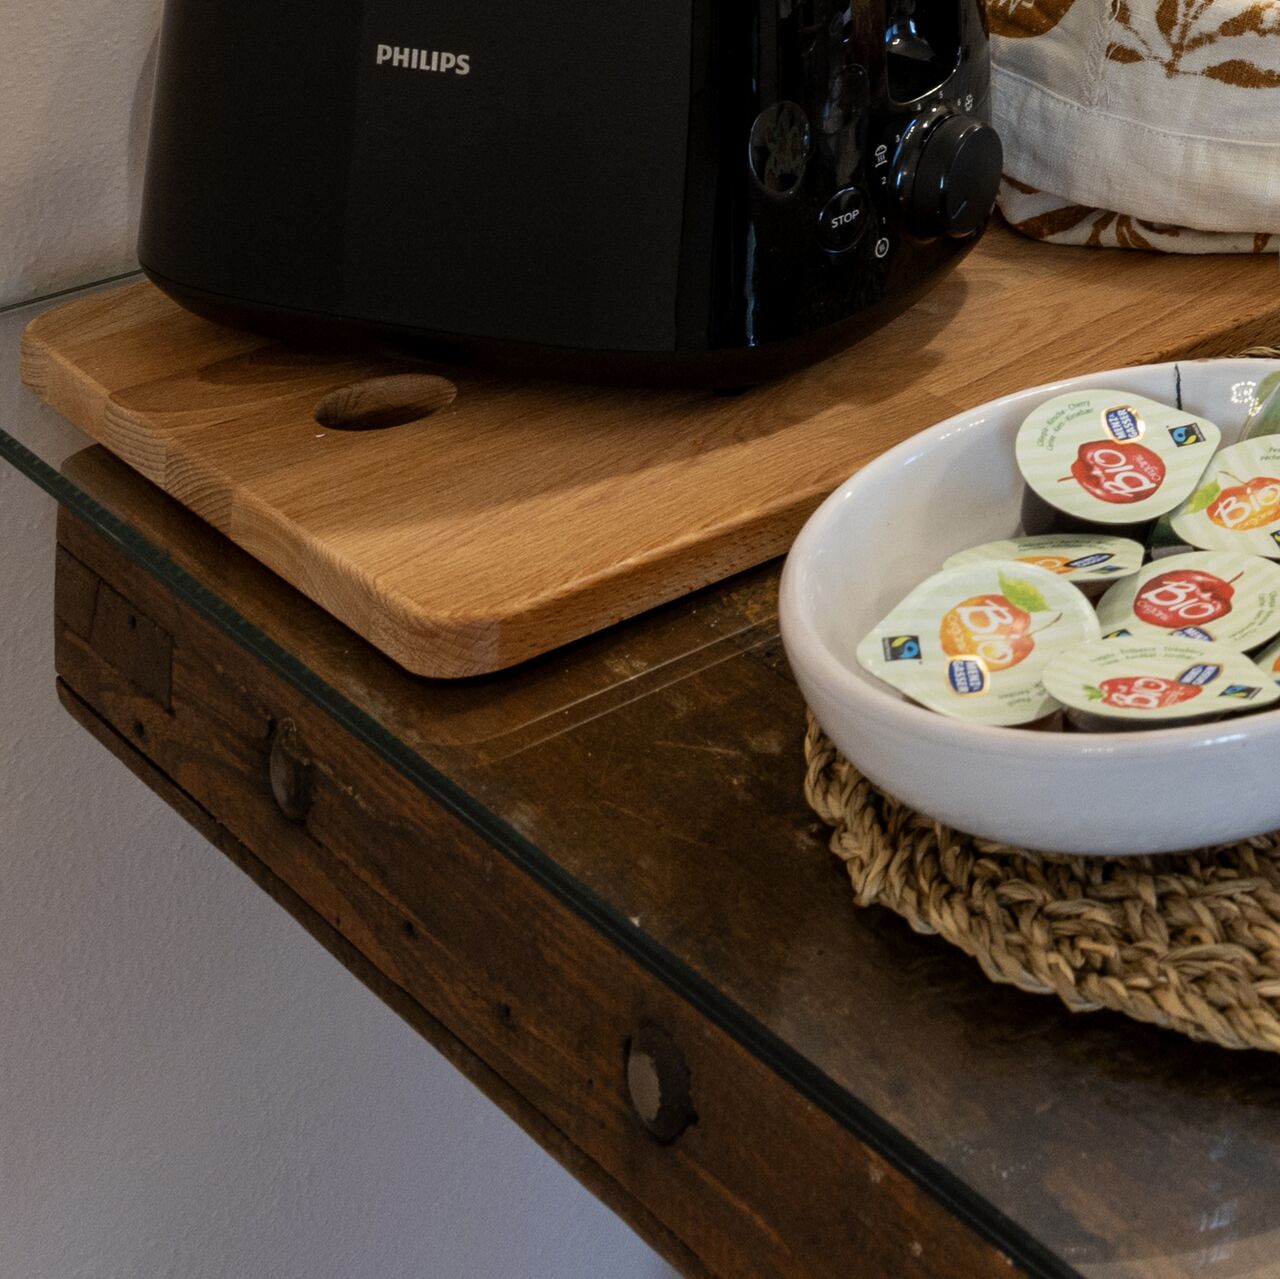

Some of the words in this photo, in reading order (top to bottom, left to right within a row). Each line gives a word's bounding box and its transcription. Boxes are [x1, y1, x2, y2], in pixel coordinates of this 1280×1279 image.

[376, 43, 471, 75] PHILIPS
[831, 209, 860, 229] STOP
[1068, 400, 1091, 411] Cherry
[1117, 408, 1138, 439] GASSER
[952, 660, 969, 694] GASSER
